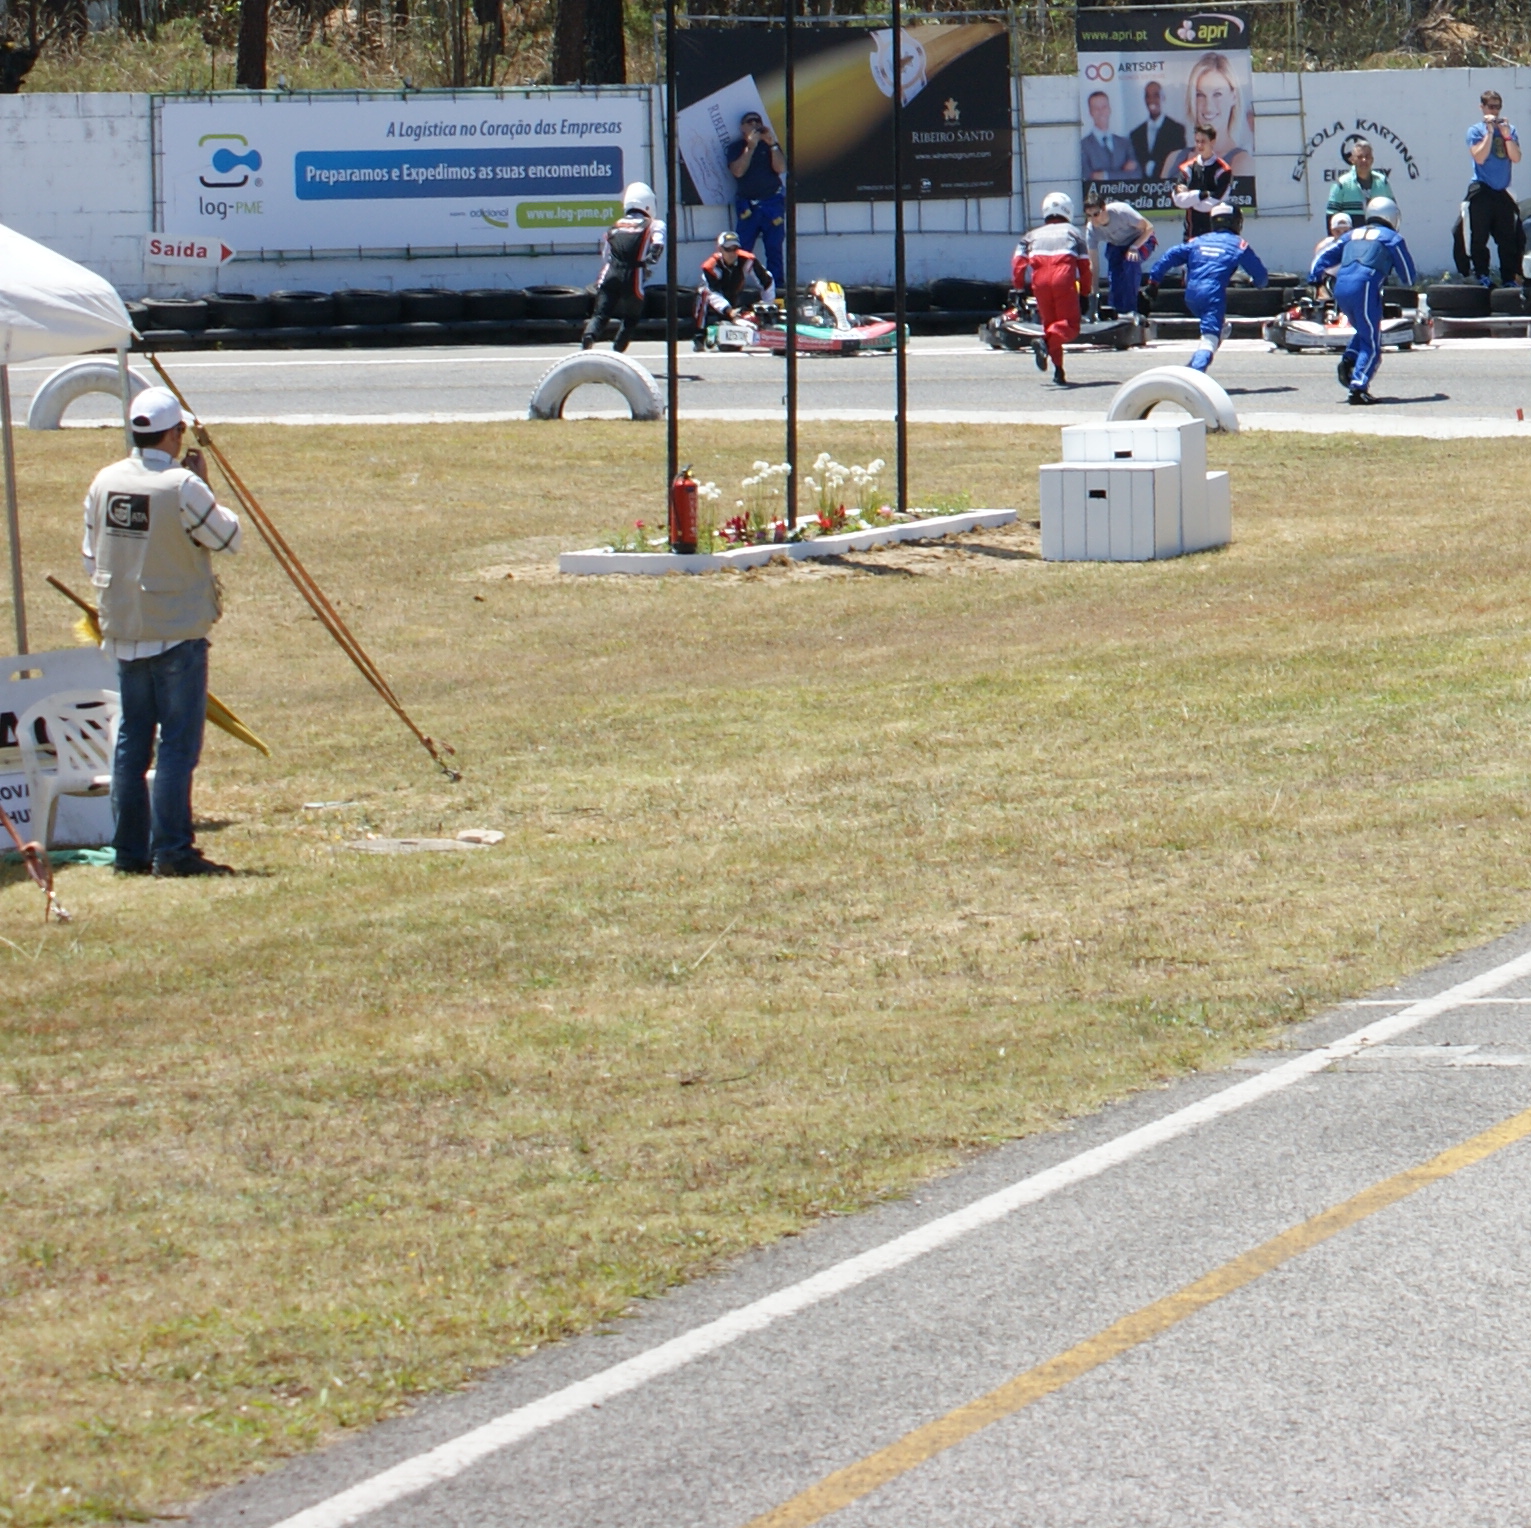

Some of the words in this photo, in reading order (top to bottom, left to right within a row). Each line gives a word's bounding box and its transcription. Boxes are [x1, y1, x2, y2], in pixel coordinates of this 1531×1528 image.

[1082, 29, 1148, 43] www.apri.pt
[1198, 21, 1229, 42] apri
[1118, 60, 1165, 72] ARTSOFT
[387, 122, 396, 137] A
[399, 122, 456, 141] Logística
[460, 124, 477, 137] no
[480, 120, 531, 140] Coração
[535, 119, 557, 135] das
[560, 120, 622, 138] Empresas
[912, 132, 955, 144] RIBEIRO
[957, 130, 995, 142] SANTO
[1292, 121, 1345, 182] ESCOLA
[1356, 118, 1419, 180] KARTING
[307, 165, 388, 185] Preparamos
[391, 169, 400, 180] e
[403, 163, 476, 184] Expedimos
[479, 166, 493, 179] as
[496, 165, 526, 179] suas
[528, 160, 612, 178] encomendas
[1088, 182, 1097, 194] A
[1100, 182, 1139, 194] melhor
[1142, 182, 1177, 196] opção
[199, 196, 264, 220] log-PME
[1156, 195, 1172, 208] da
[526, 207, 615, 221] www.log-pme.pt
[150, 240, 208, 258] Saída
